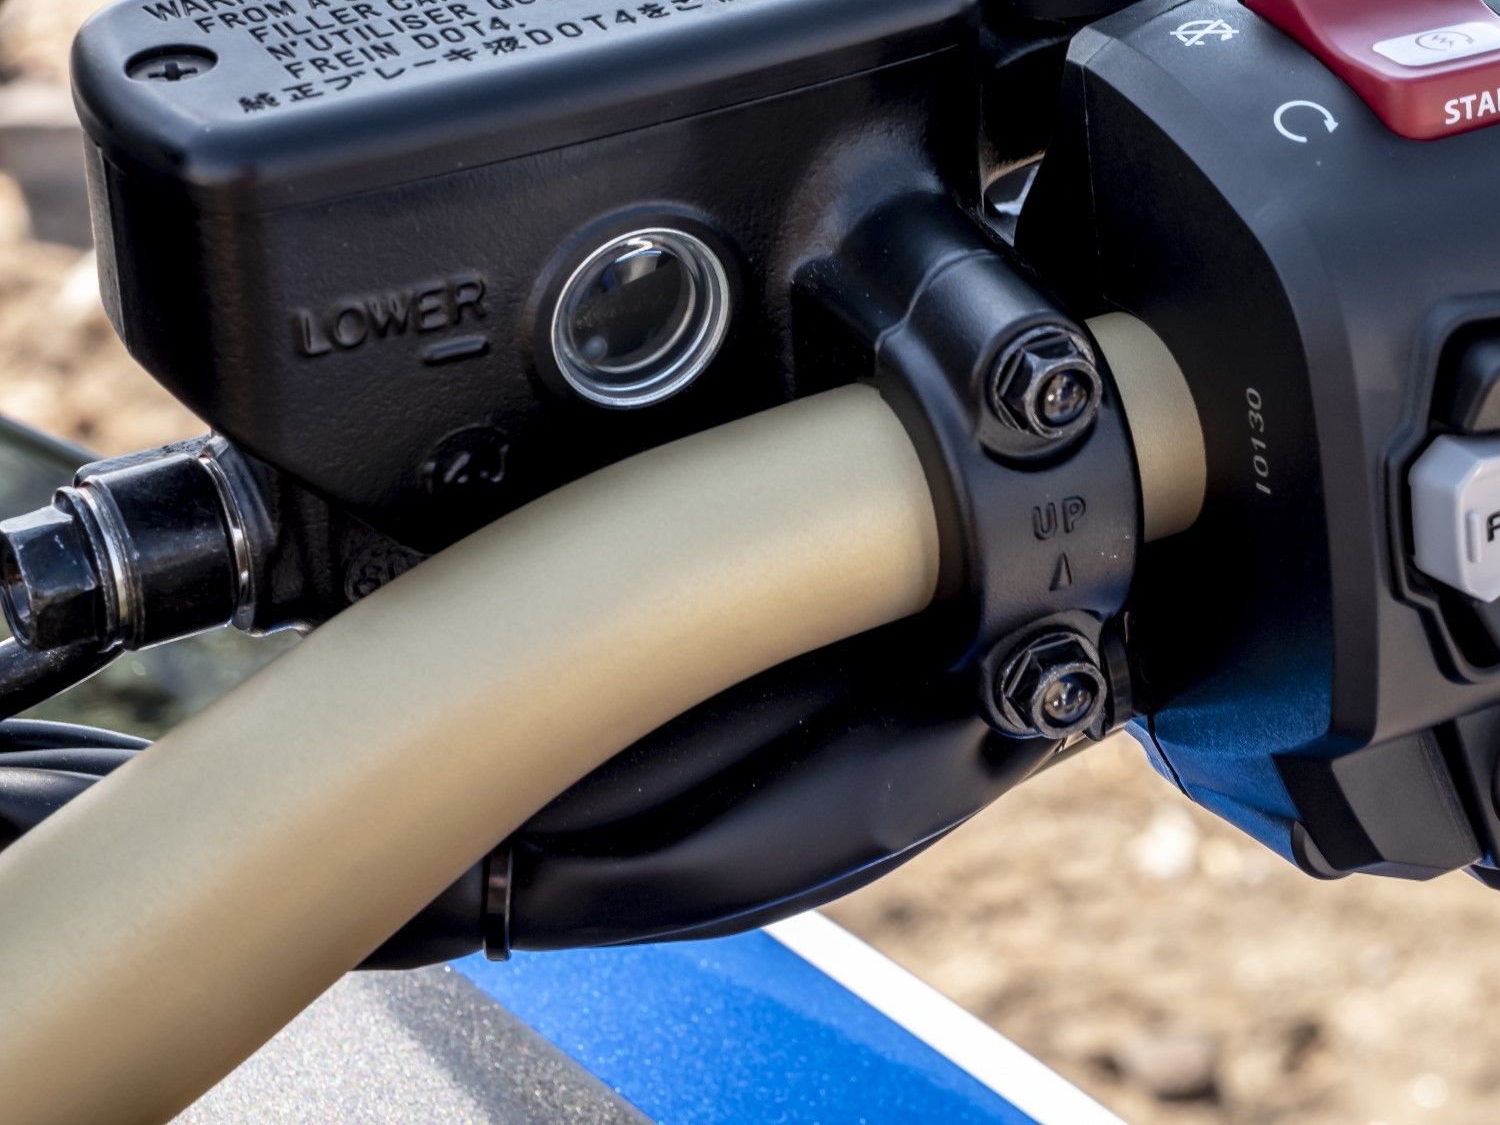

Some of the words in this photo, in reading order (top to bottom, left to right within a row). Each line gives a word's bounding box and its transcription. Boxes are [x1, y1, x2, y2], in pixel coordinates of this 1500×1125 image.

[194, 0, 297, 34] FROM
[248, 3, 382, 43] FILLER
[266, 3, 477, 61] N'UTILISER
[284, 41, 402, 79] FREIN
[411, 16, 527, 50] DOT4.
[298, 274, 489, 357] LOWER
[1031, 494, 1086, 541] UP
